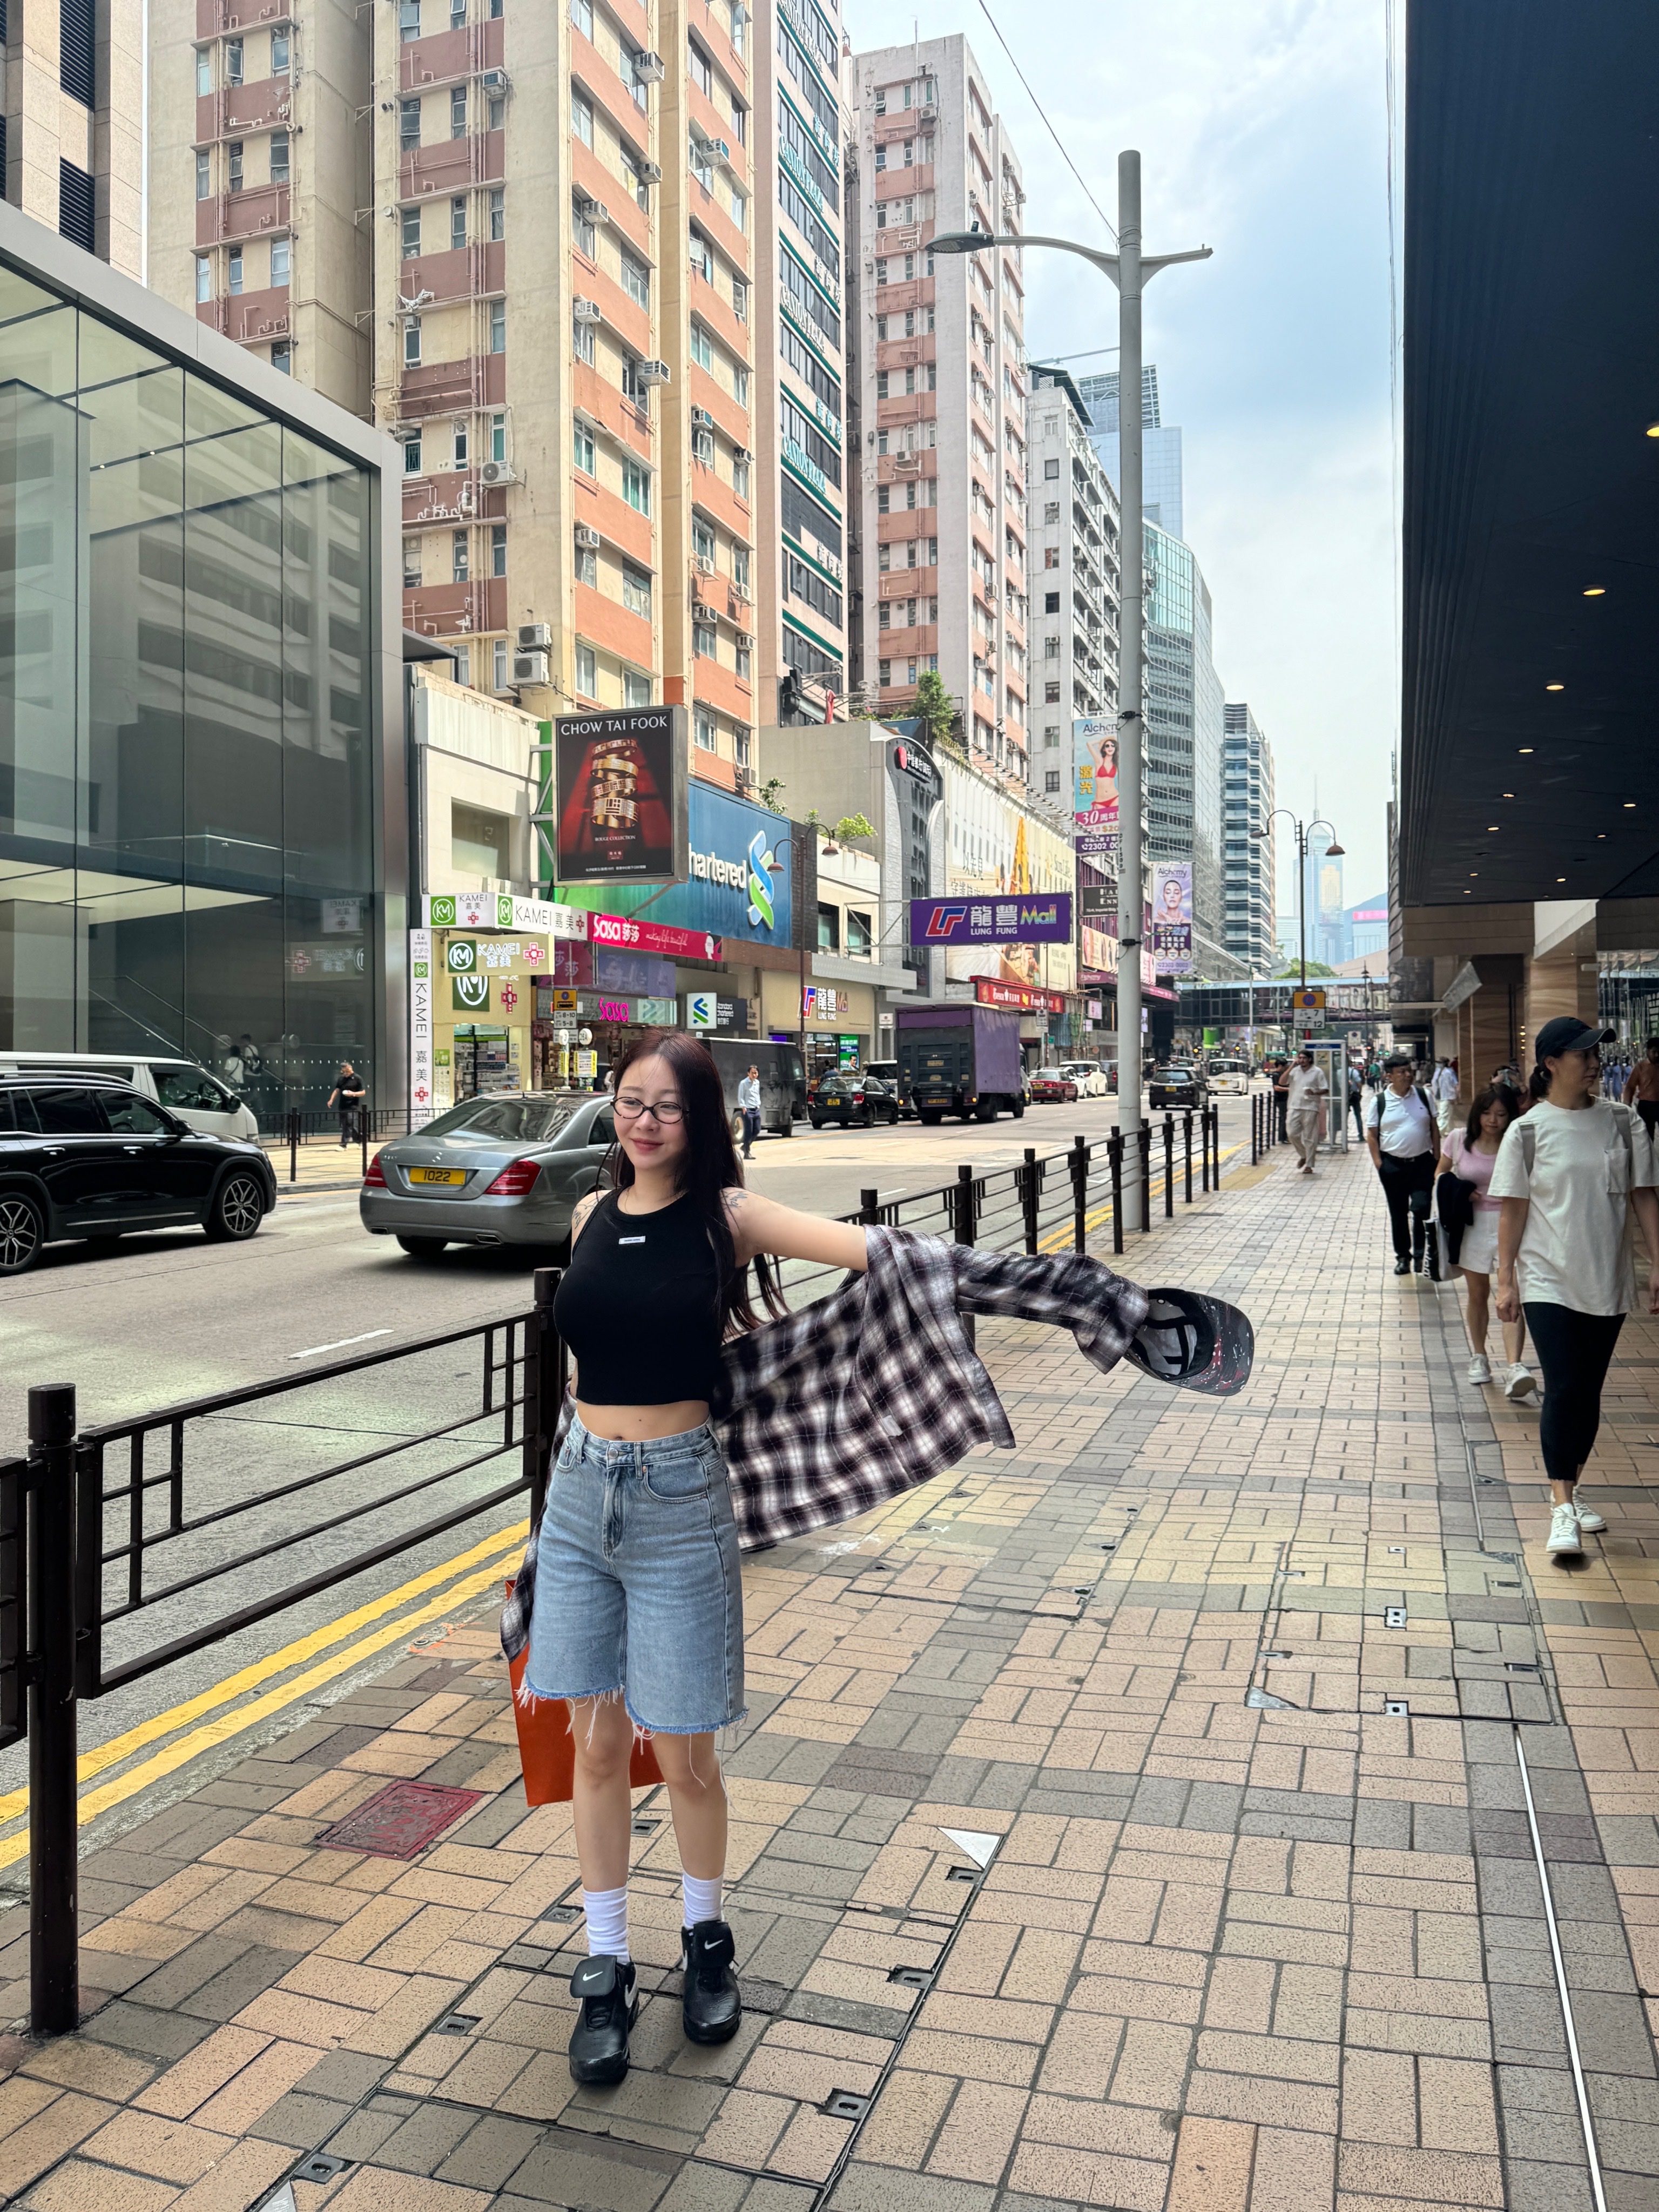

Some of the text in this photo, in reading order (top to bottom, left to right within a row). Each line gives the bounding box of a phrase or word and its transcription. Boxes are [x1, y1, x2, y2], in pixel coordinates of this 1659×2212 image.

[779, 133, 805, 184] CANTON
[780, 282, 807, 329] CANTON
[781, 434, 808, 475] CANTON
[561, 716, 667, 735] CHOW TAI FOOK
[1082, 811, 1099, 825] 30
[1089, 842, 1107, 851] 2302
[689, 842, 746, 888] hartered
[1158, 868, 1187, 878] Alchemy
[516, 905, 551, 926] KAMEI
[970, 904, 1056, 927] 龍豐 Mall
[622, 923, 639, 942] 莎莎
[477, 942, 520, 956] KAMEI
[415, 983, 427, 1038] KAMEI
[416, 1051, 427, 1081] 嘉美
[424, 1171, 450, 1182] 1022
